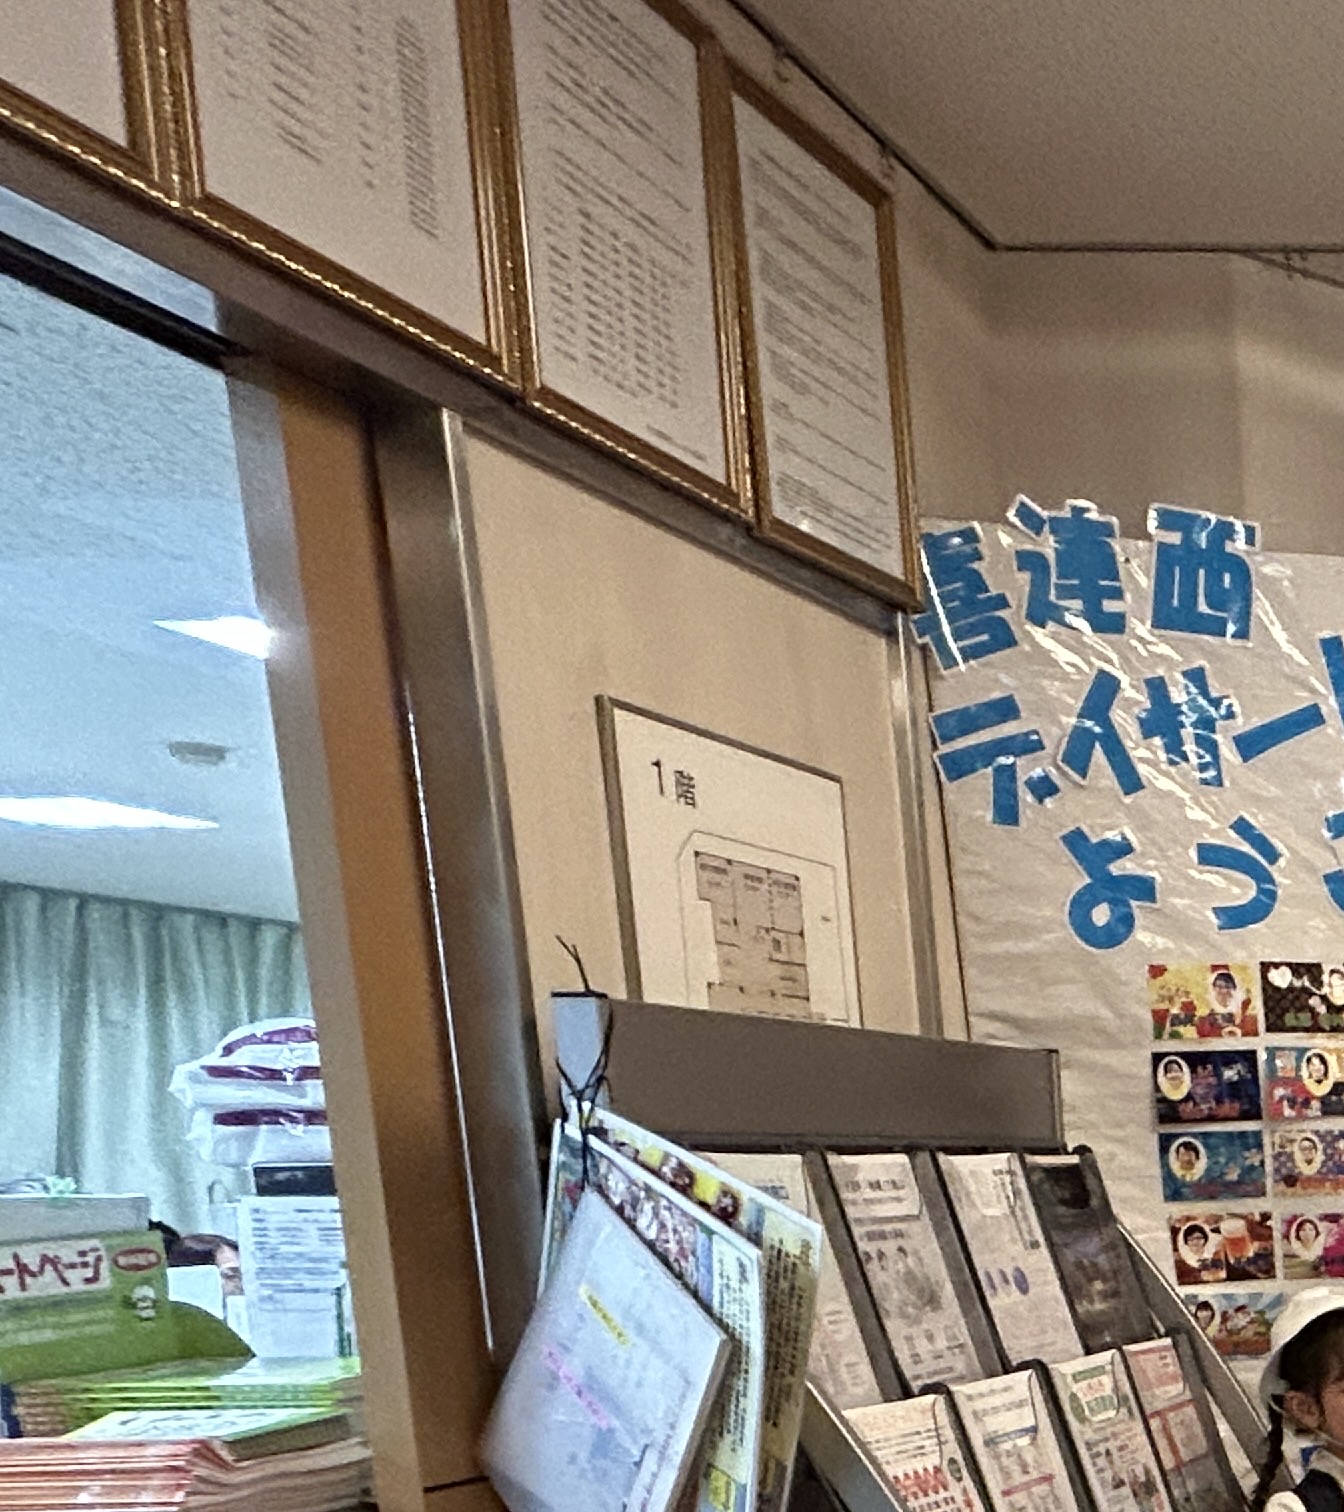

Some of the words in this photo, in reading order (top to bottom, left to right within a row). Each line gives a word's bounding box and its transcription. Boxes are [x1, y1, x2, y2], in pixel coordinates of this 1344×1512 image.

[0, 1246, 104, 1294] ートページ
